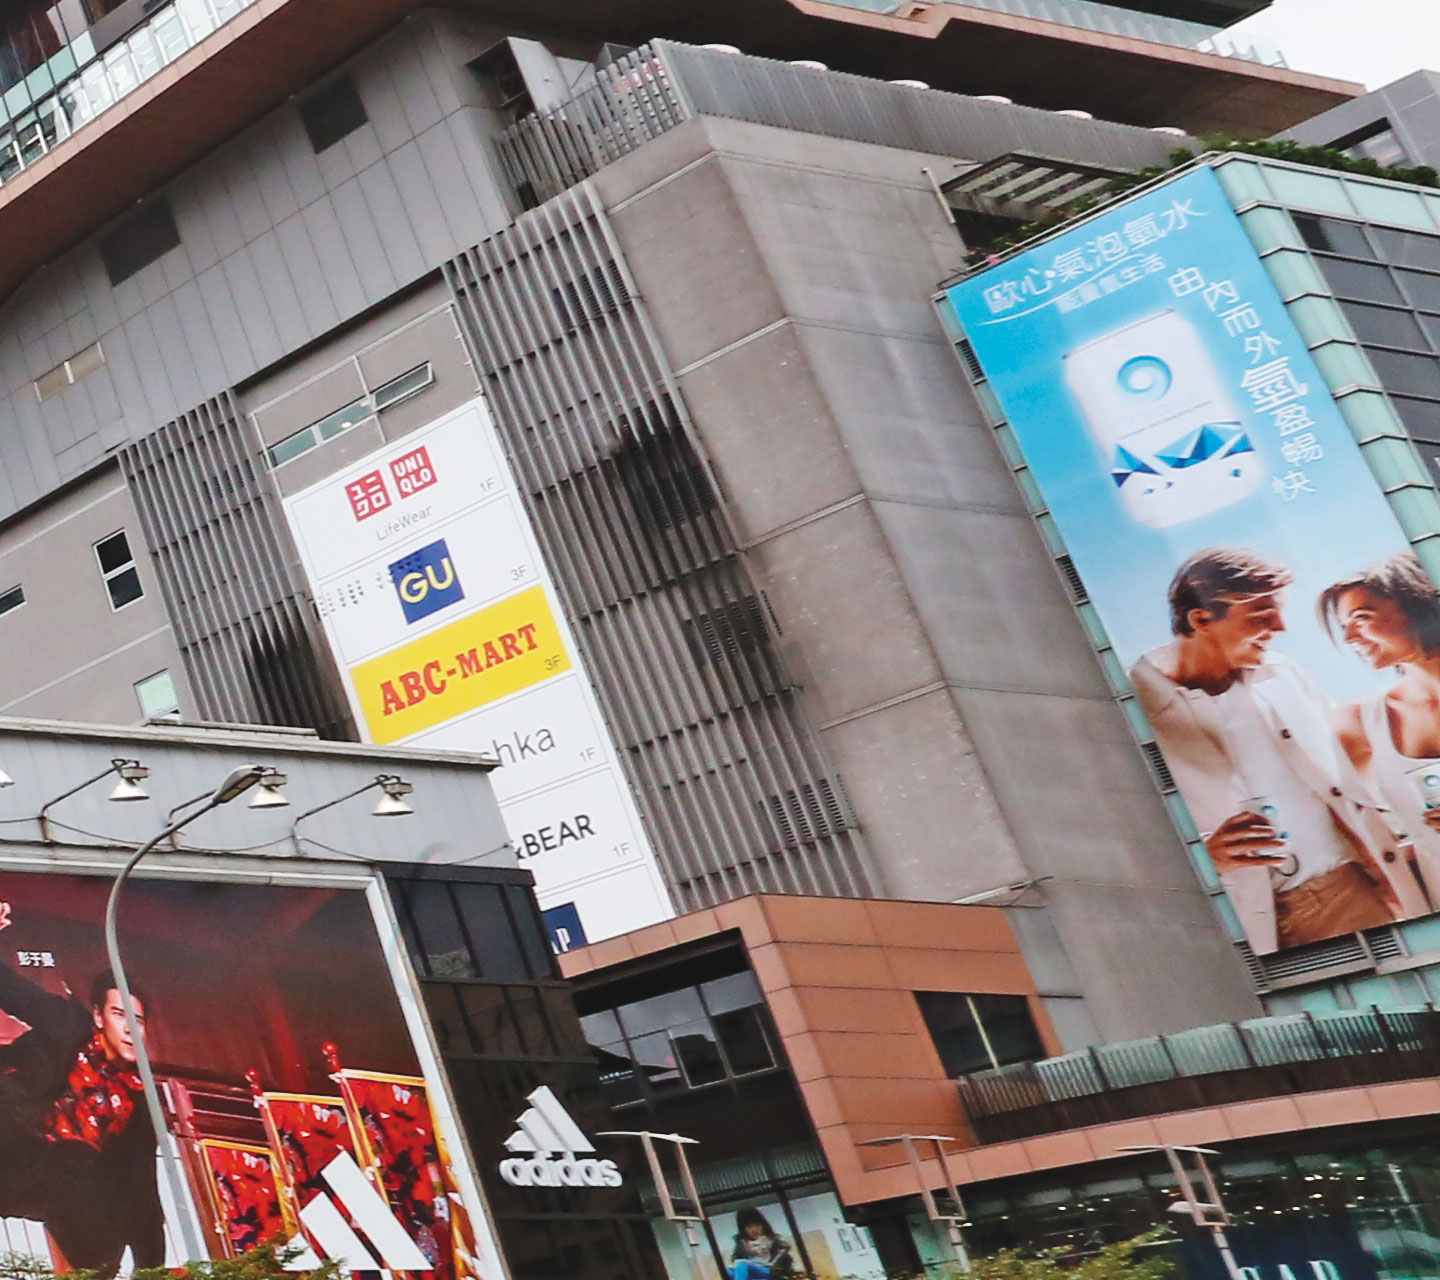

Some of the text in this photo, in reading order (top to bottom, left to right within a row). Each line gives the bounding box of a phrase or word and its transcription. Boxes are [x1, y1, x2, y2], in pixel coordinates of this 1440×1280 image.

[480, 476, 495, 493] 1F
[376, 505, 432, 541] LifeWear
[399, 557, 455, 604] GU
[510, 564, 527, 582] 3F
[380, 623, 539, 716] ABC-MART
[544, 654, 562, 672] 3F
[579, 746, 597, 763] 1F
[612, 842, 629, 859] 1F
[551, 927, 571, 956] AP
[17, 951, 55, 968] 彭于晏
[499, 1156, 623, 1188] adidas
